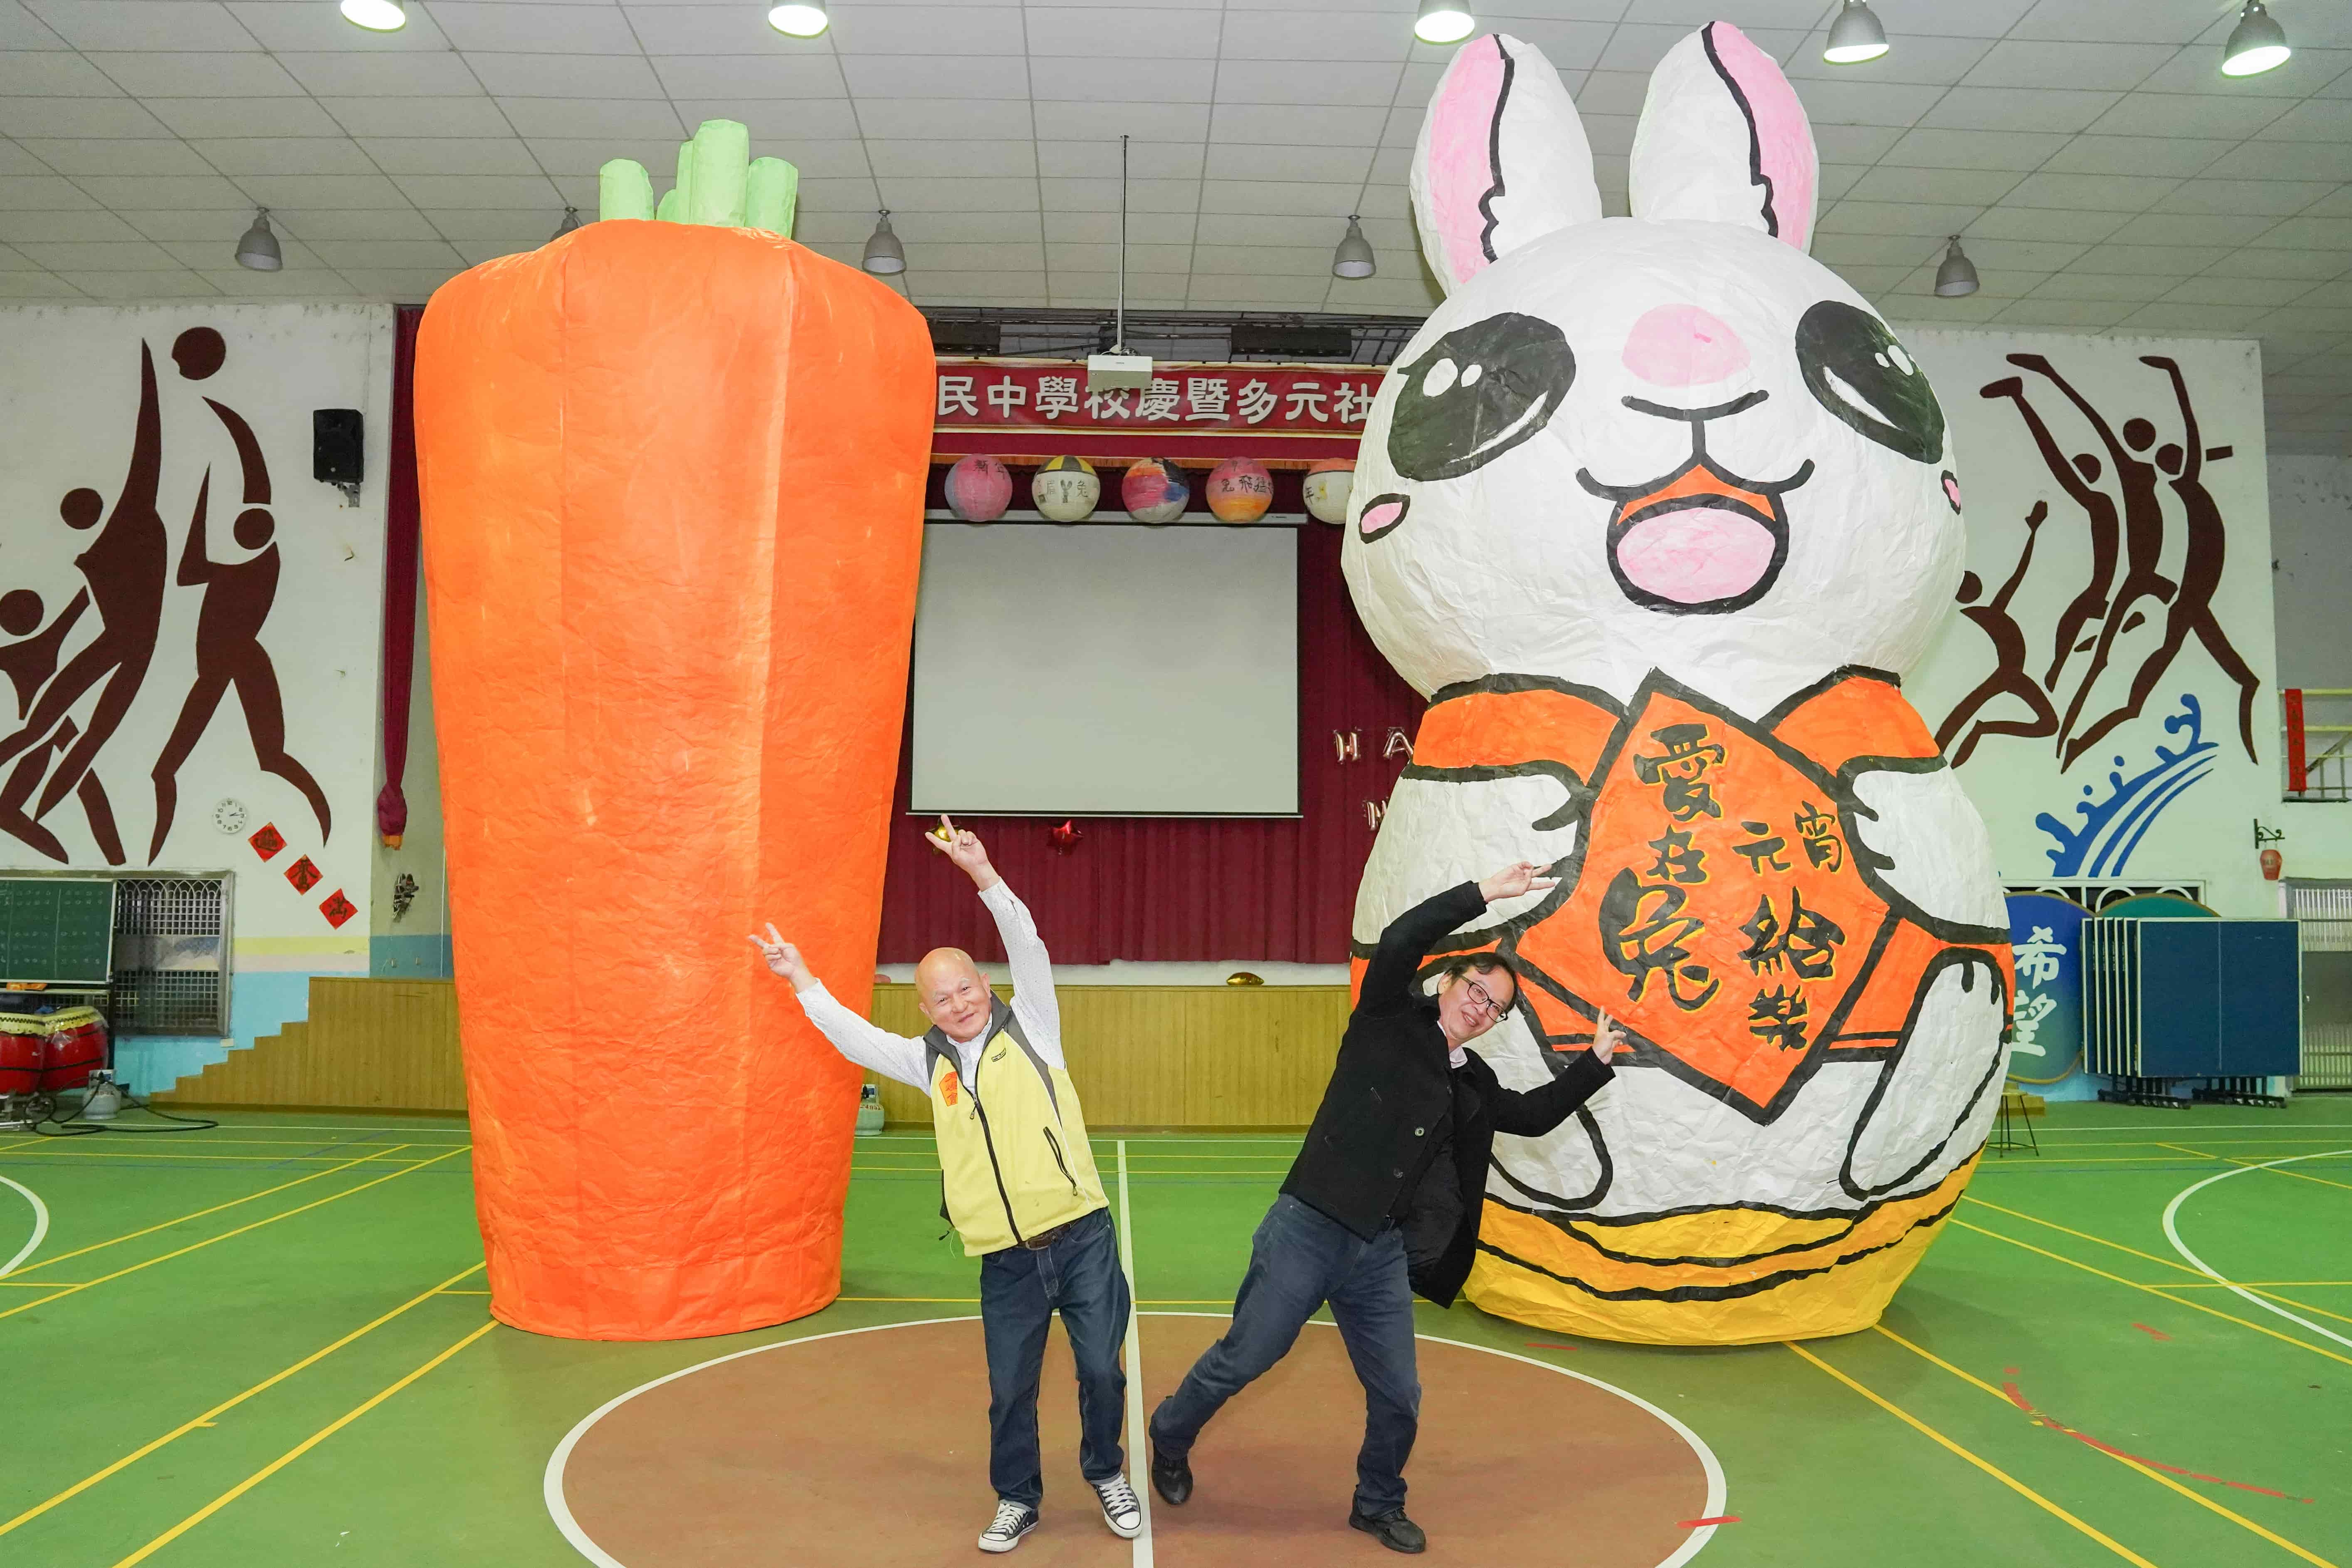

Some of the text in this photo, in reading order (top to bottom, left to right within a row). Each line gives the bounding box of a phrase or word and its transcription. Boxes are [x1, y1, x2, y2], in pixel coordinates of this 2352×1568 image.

[938, 375, 1375, 424] 民中學校慶暨多元社
[2011, 926, 2067, 1057] 希望
